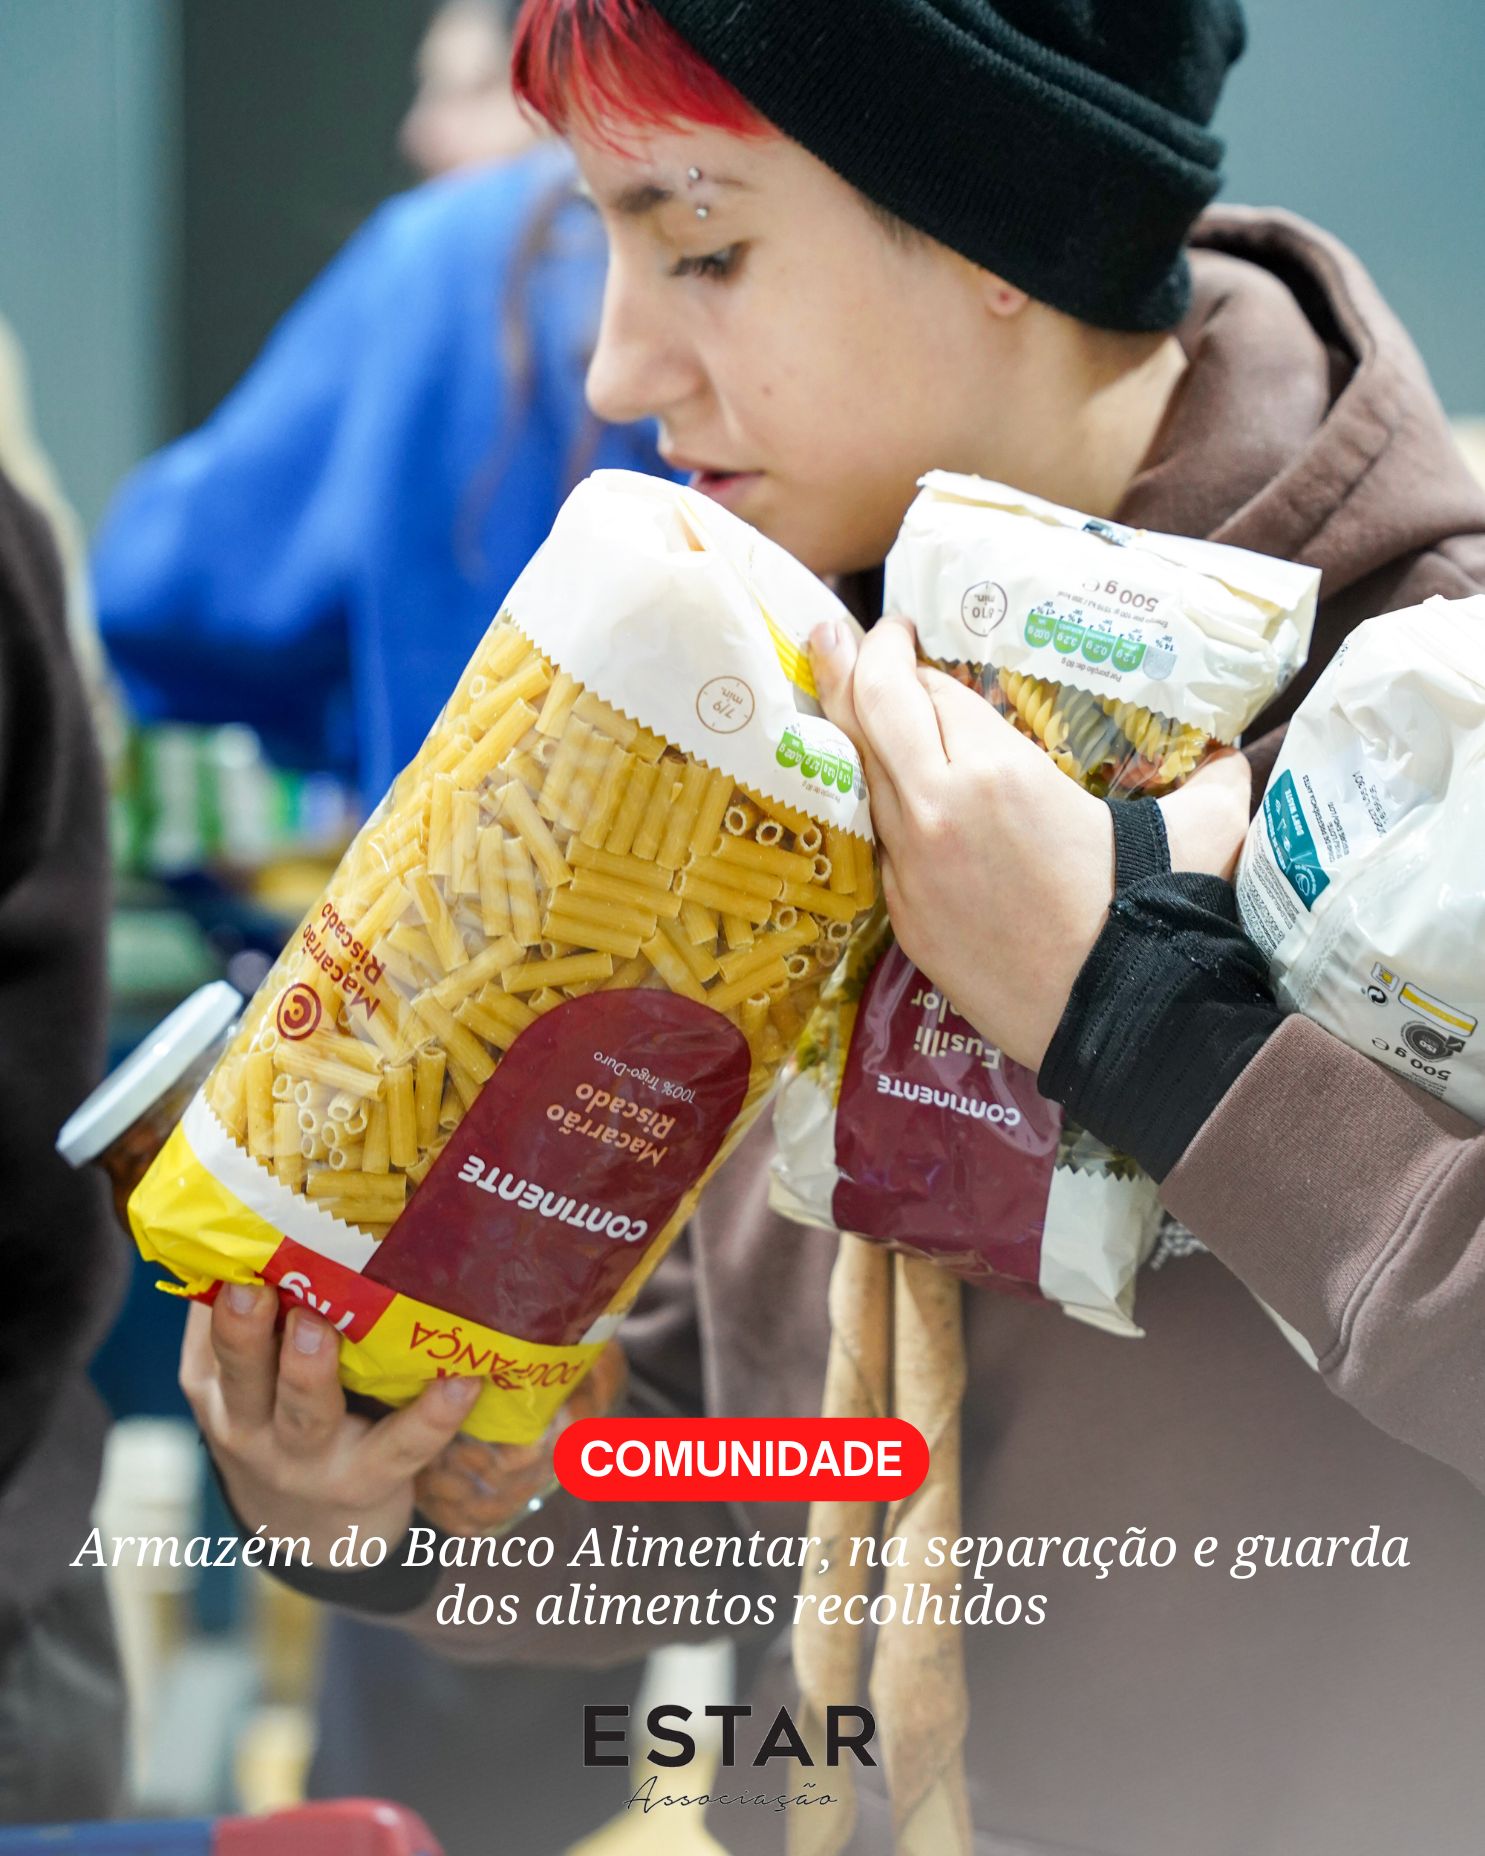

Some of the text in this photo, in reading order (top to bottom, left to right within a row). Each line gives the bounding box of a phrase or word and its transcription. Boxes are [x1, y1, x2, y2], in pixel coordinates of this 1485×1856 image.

[1103, 579, 1159, 613] 500 g
[712, 700, 736, 720] 7/9
[720, 686, 744, 707] min.
[321, 902, 387, 986] Riscado
[302, 924, 381, 1021] Macarrão
[913, 1024, 1001, 1070] Fusilli
[1394, 1046, 1407, 1058] g
[1410, 1057, 1452, 1082] 500
[592, 1050, 697, 1105] 100% Trigo-Duro
[876, 1074, 1021, 1126] CONTINENTE
[545, 1104, 668, 1168] Macarrão
[574, 1083, 676, 1139] Riscado
[457, 1154, 648, 1243] CONTINENTE
